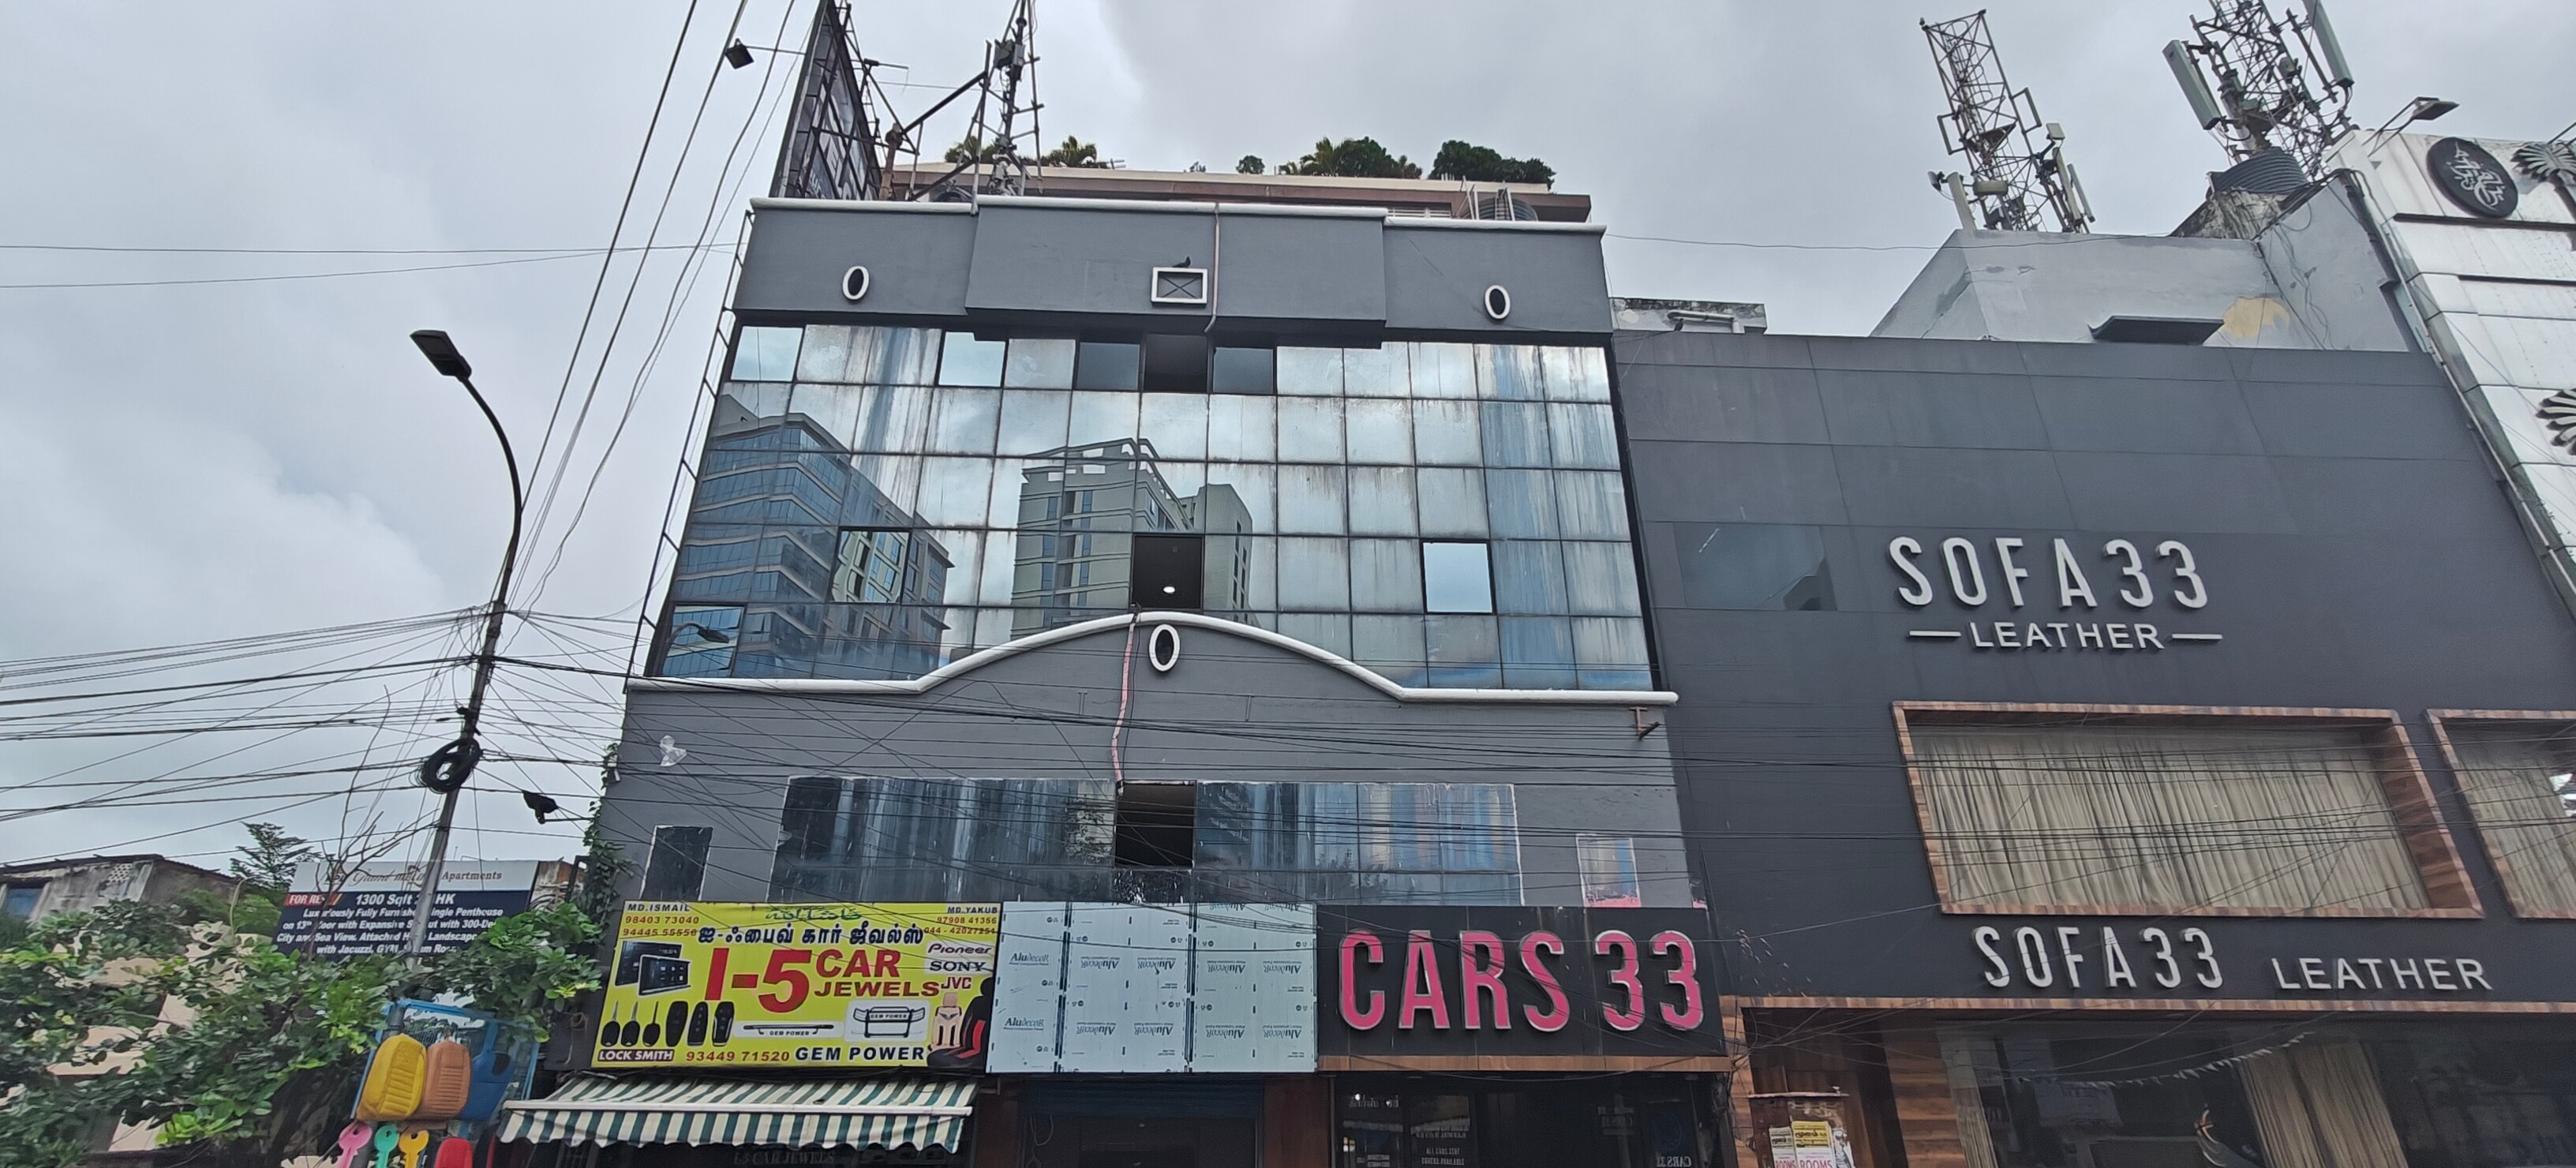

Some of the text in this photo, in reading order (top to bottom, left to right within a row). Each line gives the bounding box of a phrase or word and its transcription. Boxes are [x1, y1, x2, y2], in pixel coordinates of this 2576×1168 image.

[1970, 622, 2165, 650] LEATHER
[442, 871, 503, 882] Apartments
[289, 894, 325, 904] FOR RE
[356, 894, 385, 905] 1300
[386, 893, 413, 907] Sqft
[355, 908, 378, 919] Fully
[431, 908, 453, 919] ingle
[455, 908, 504, 917] Penthouse
[627, 904, 691, 912] MD.ISMAIL
[338, 920, 358, 929] with
[440, 919, 460, 928] with
[277, 933, 294, 944] City
[314, 932, 331, 942] Sea
[623, 928, 658, 937] 94445
[802, 923, 842, 944] கார்
[849, 920, 924, 945] ஜீவல்ஸ்
[316, 945, 337, 953] with
[927, 943, 992, 954] Pioneer
[815, 949, 901, 978] CAR
[930, 960, 987, 971] SONY
[2271, 957, 2492, 990] LEATHER
[704, 947, 813, 1013] I-5
[941, 976, 972, 990] JVC
[1339, 929, 1704, 1032] CARS 33
[814, 981, 939, 998] JEWELS
[598, 1050, 673, 1061] LOCK SMITH
[686, 1051, 790, 1061] 93449 71520
[795, 1047, 924, 1061] GEM POWER
